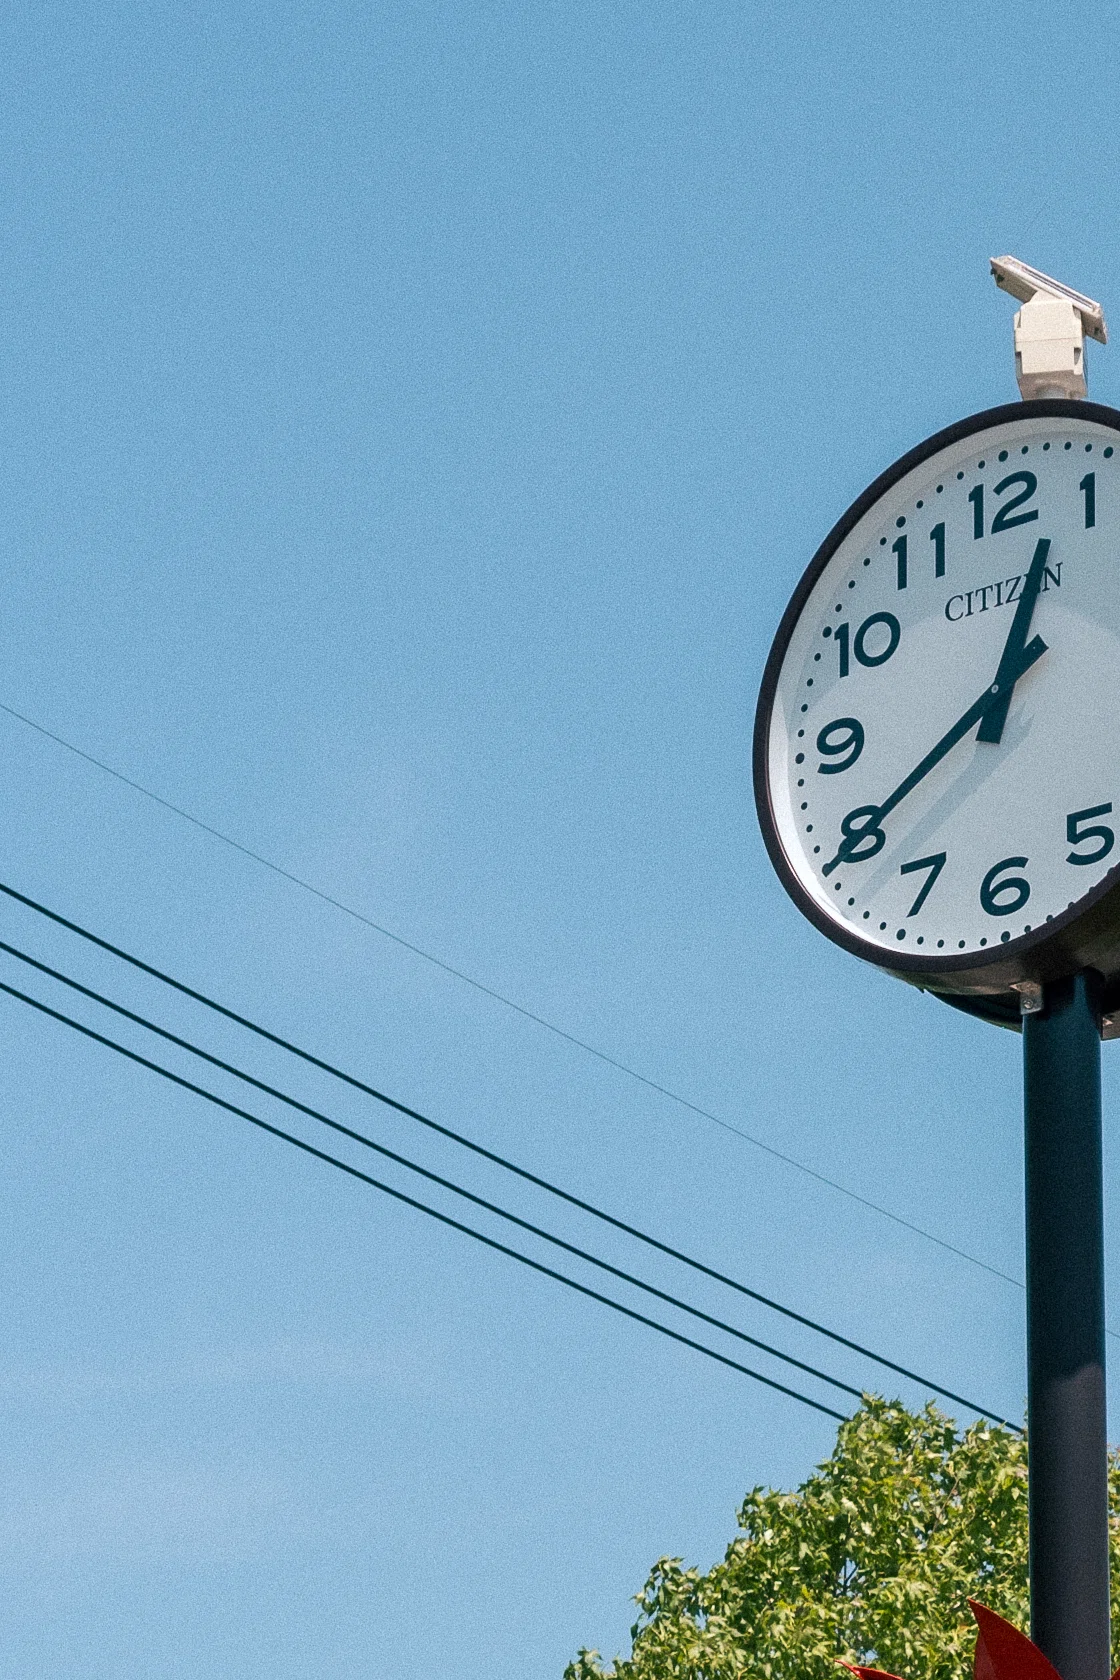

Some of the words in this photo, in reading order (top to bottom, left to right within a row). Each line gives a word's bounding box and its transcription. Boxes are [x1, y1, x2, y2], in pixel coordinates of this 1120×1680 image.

[969, 471, 1039, 539] 12
[1080, 472, 1096, 529] 1
[892, 522, 946, 590] 11
[944, 561, 1063, 622] CITIZN
[834, 612, 901, 677] 10
[817, 718, 865, 774] 9
[1066, 803, 1115, 866] 5
[901, 852, 947, 917] 7
[980, 857, 1031, 917] 6
